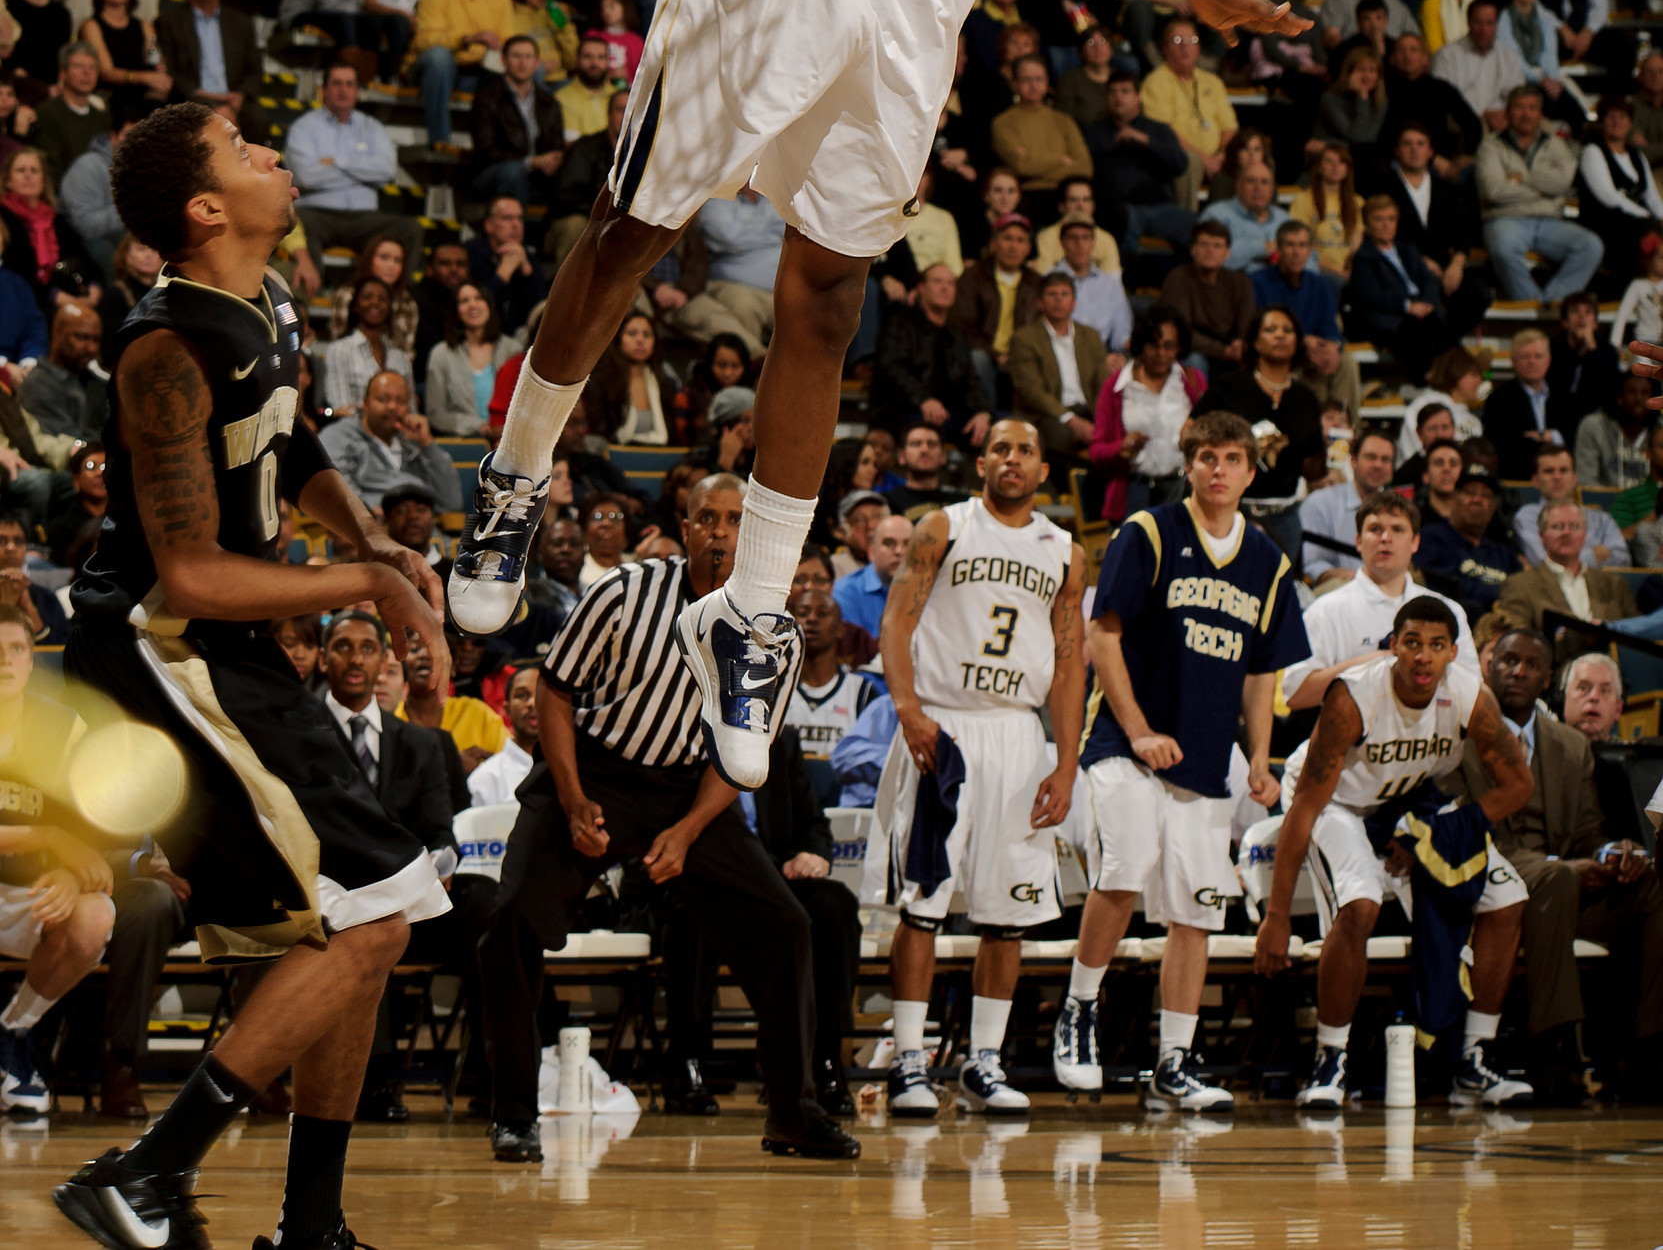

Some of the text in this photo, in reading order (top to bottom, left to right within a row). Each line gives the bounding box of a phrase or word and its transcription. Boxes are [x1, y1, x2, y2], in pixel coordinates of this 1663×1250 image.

[951, 556, 1057, 607] GEORGIA
[1167, 576, 1261, 628] GEORGIA
[981, 602, 1020, 660] 3
[1183, 617, 1243, 662] TECH
[961, 662, 1025, 698] TECH
[1009, 882, 1043, 905] GT
[1194, 886, 1227, 911] GT
